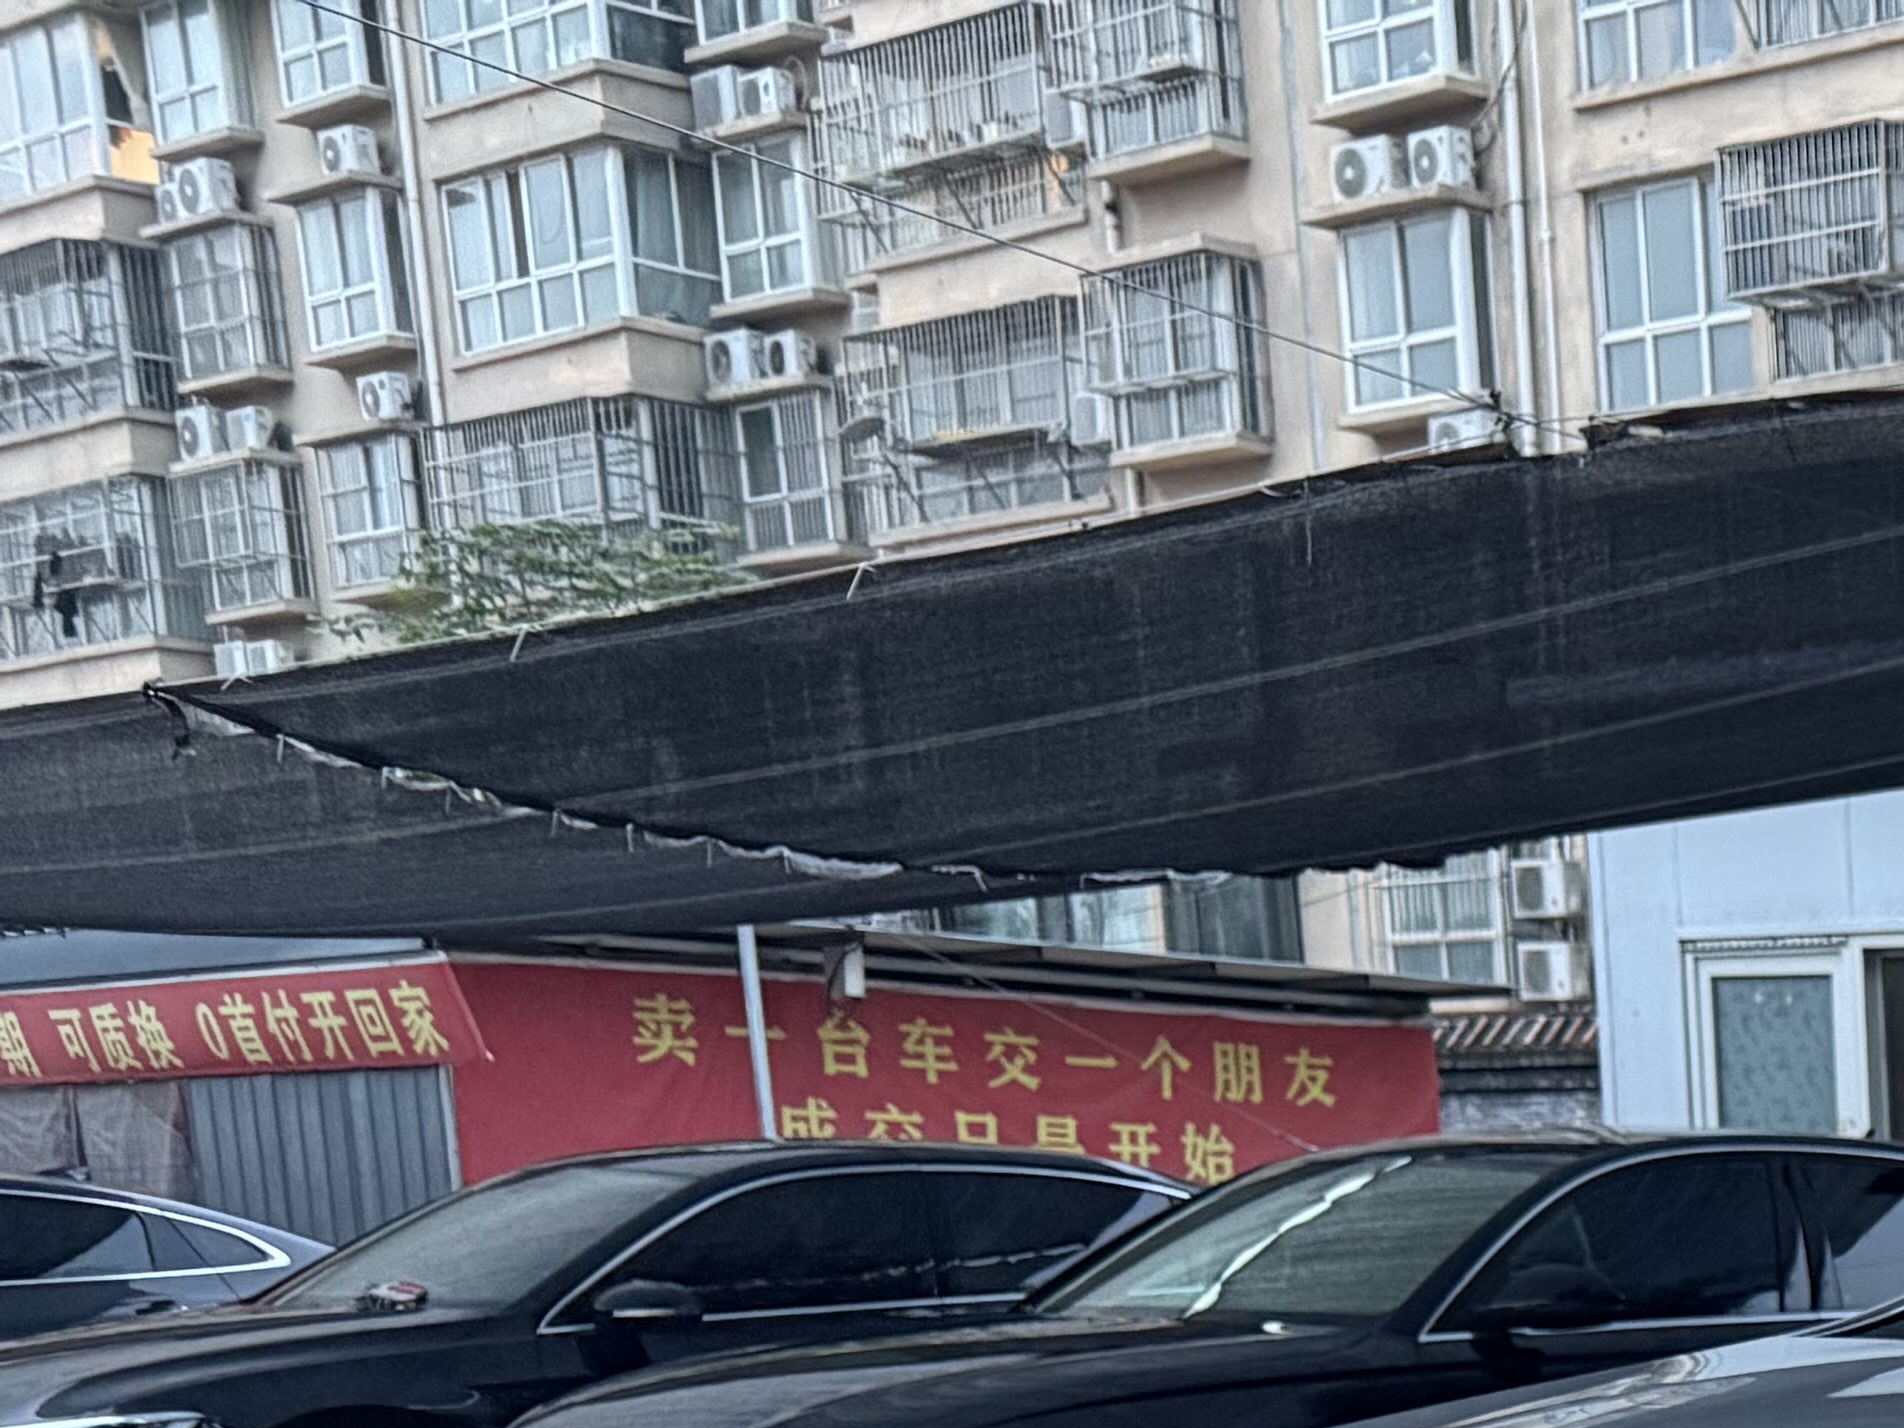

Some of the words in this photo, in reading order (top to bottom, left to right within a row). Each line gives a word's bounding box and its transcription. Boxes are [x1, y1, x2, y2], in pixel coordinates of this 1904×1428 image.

[48, 999, 184, 1073] 可质换
[195, 979, 449, 1064] 0首付开回家
[631, 995, 1336, 1107] 卖一台车交一个朋友
